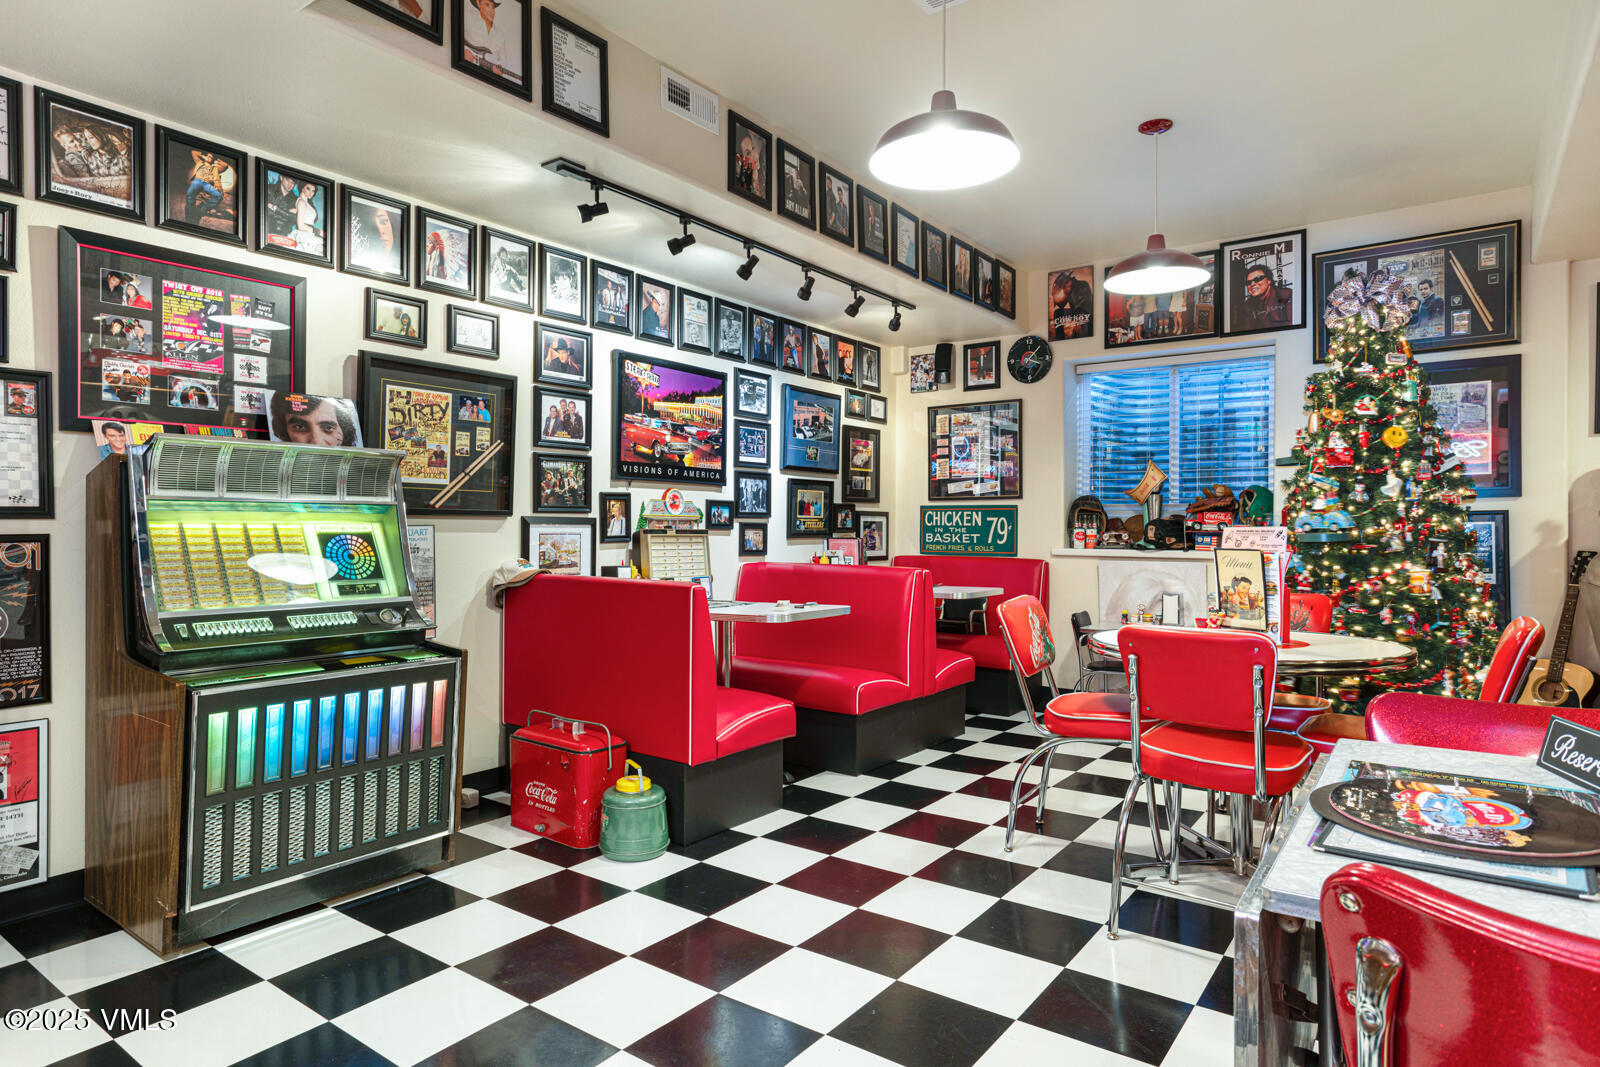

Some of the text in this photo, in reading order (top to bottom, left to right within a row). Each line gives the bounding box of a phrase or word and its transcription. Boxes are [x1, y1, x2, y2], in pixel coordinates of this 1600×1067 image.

[1232, 250, 1271, 261] RONNIE
[389, 401, 450, 427] DIRTY
[185, 424, 199, 436] TOP
[199, 427, 211, 437] HIT
[622, 464, 721, 479] VISIONS OF AMERICA
[925, 511, 982, 526] CHICKEN
[926, 533, 981, 543] BASKET
[1222, 555, 1254, 569] Menu
[525, 781, 559, 805] Coca-Cola
